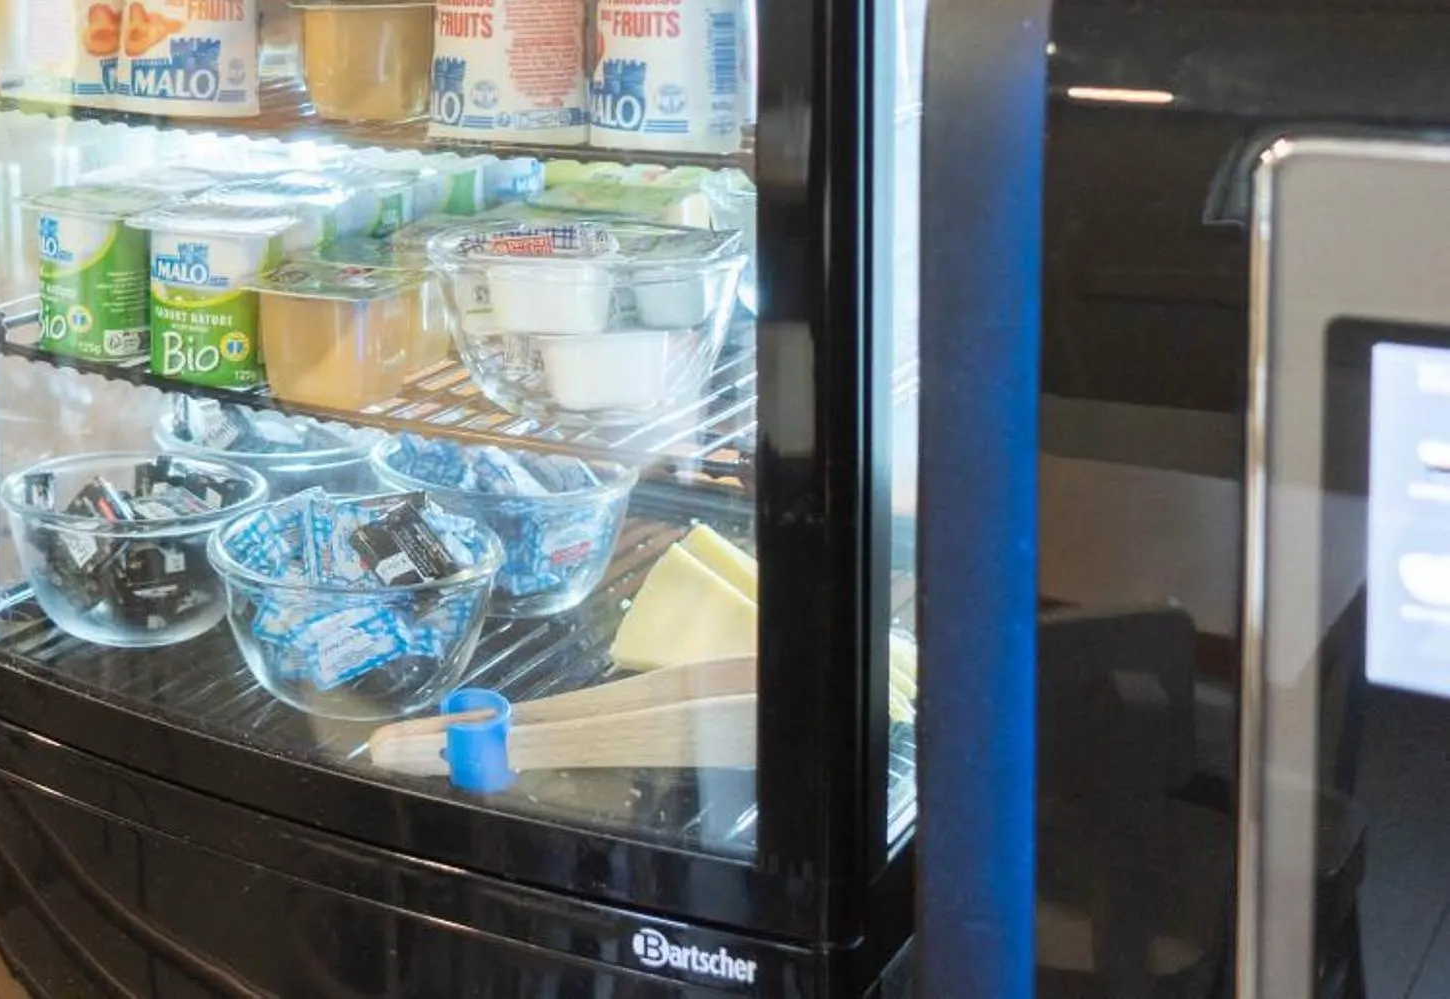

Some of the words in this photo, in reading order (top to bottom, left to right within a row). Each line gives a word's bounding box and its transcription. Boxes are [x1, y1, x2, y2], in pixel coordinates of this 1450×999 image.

[612, 11, 681, 38] FRUITS
[134, 68, 217, 100] MALO
[157, 260, 209, 284] MALO
[161, 331, 220, 376] Bio
[632, 927, 758, 984] Bartscher
